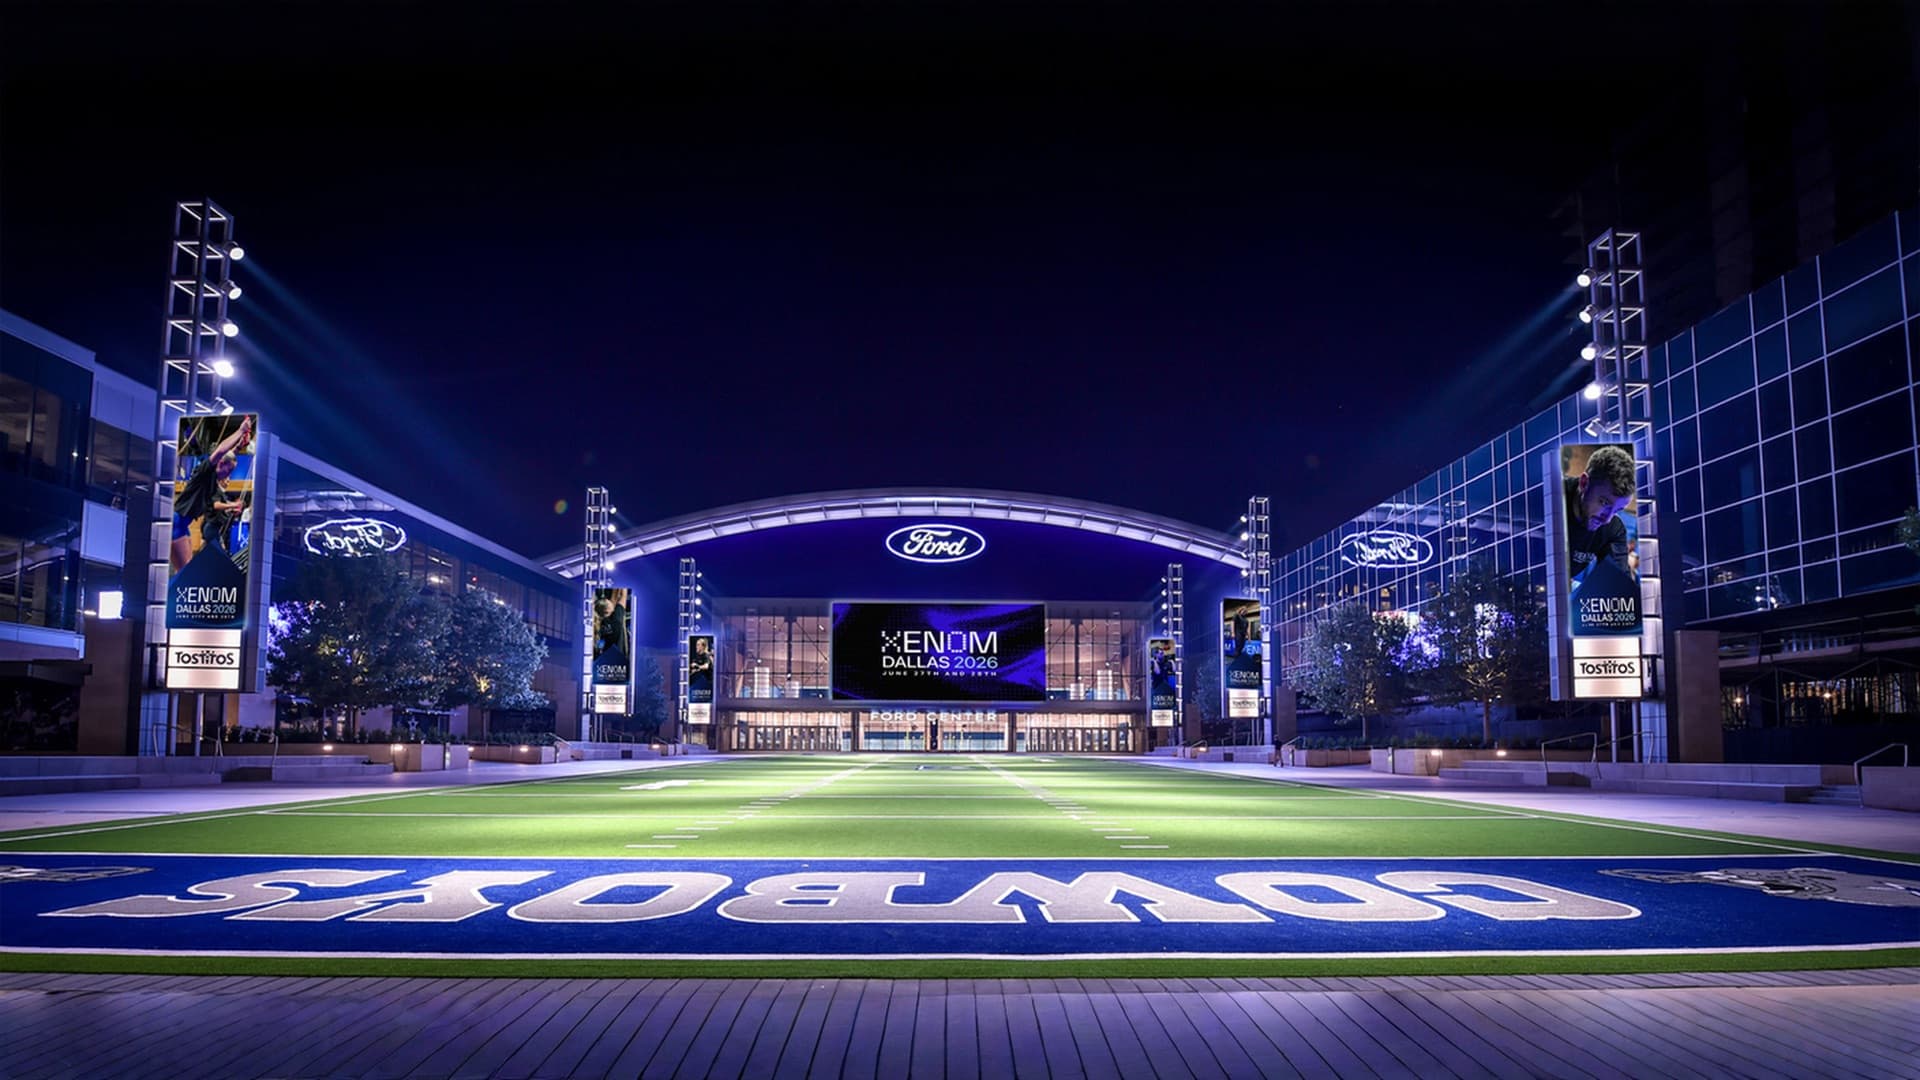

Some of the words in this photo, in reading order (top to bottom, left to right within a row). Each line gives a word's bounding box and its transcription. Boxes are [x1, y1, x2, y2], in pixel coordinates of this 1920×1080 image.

[903, 529, 968, 555] Ford
[176, 587, 237, 602] XENOM
[176, 604, 211, 613] DALLAS
[212, 604, 236, 614] 2026
[1580, 598, 1635, 613] XENOM
[1581, 613, 1614, 623] DALLAS
[1614, 612, 1636, 621] 2026
[881, 631, 998, 654] XENOM
[882, 656, 950, 669] DALLAS
[954, 656, 998, 669] 2026
[870, 711, 917, 721] FORD
[926, 711, 997, 721] CENTER
[37, 868, 1642, 923] COWBOYS
